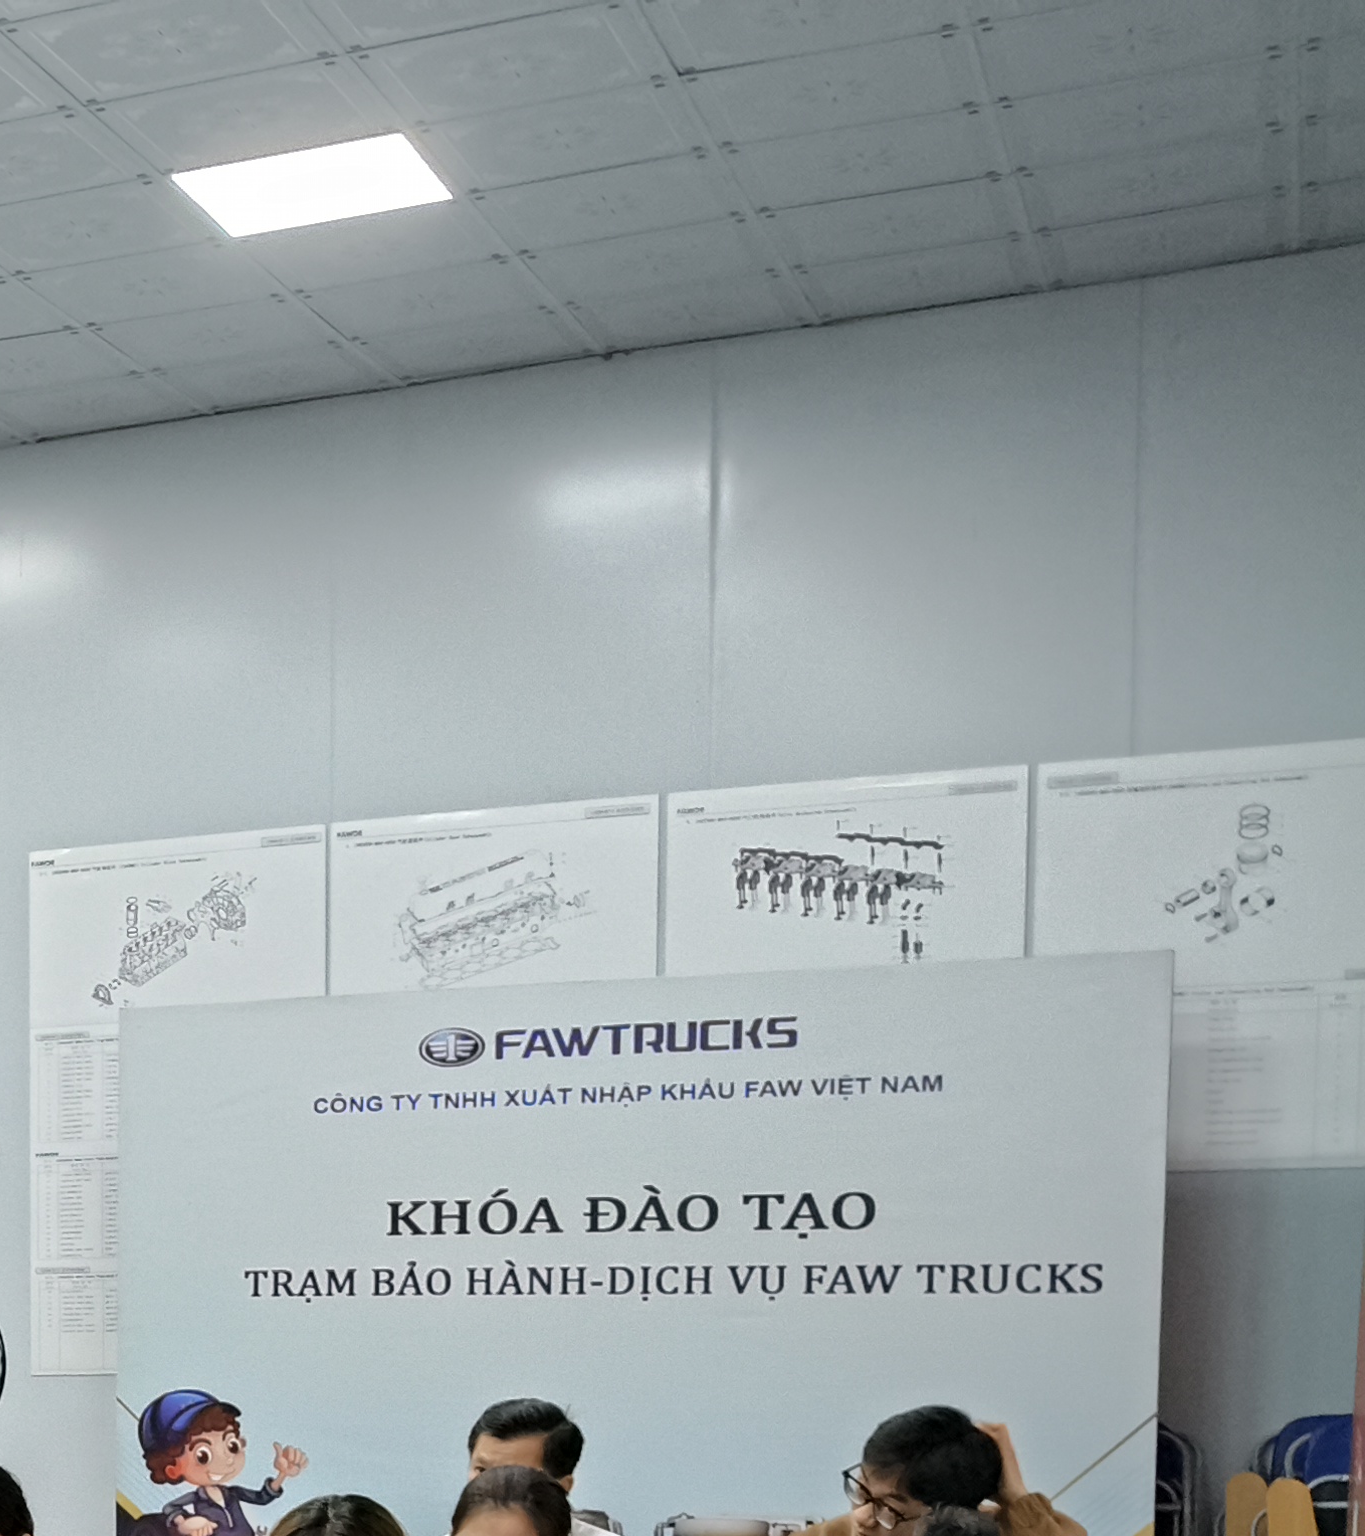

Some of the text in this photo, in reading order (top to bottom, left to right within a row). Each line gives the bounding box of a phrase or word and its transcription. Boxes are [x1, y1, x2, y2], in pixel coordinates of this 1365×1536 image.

[495, 1016, 798, 1060] FAWTRUCKS
[313, 1074, 944, 1114] CÔNG TY TNHH XUẤT NHẬP KHẨU FAW VIỆT NAM
[386, 1184, 877, 1239] KHÓA ĐÀO TẠO
[244, 1259, 1104, 1303] TRẠM BẢO HÀNH-DỊCH VỤ FAW TRUCKS
